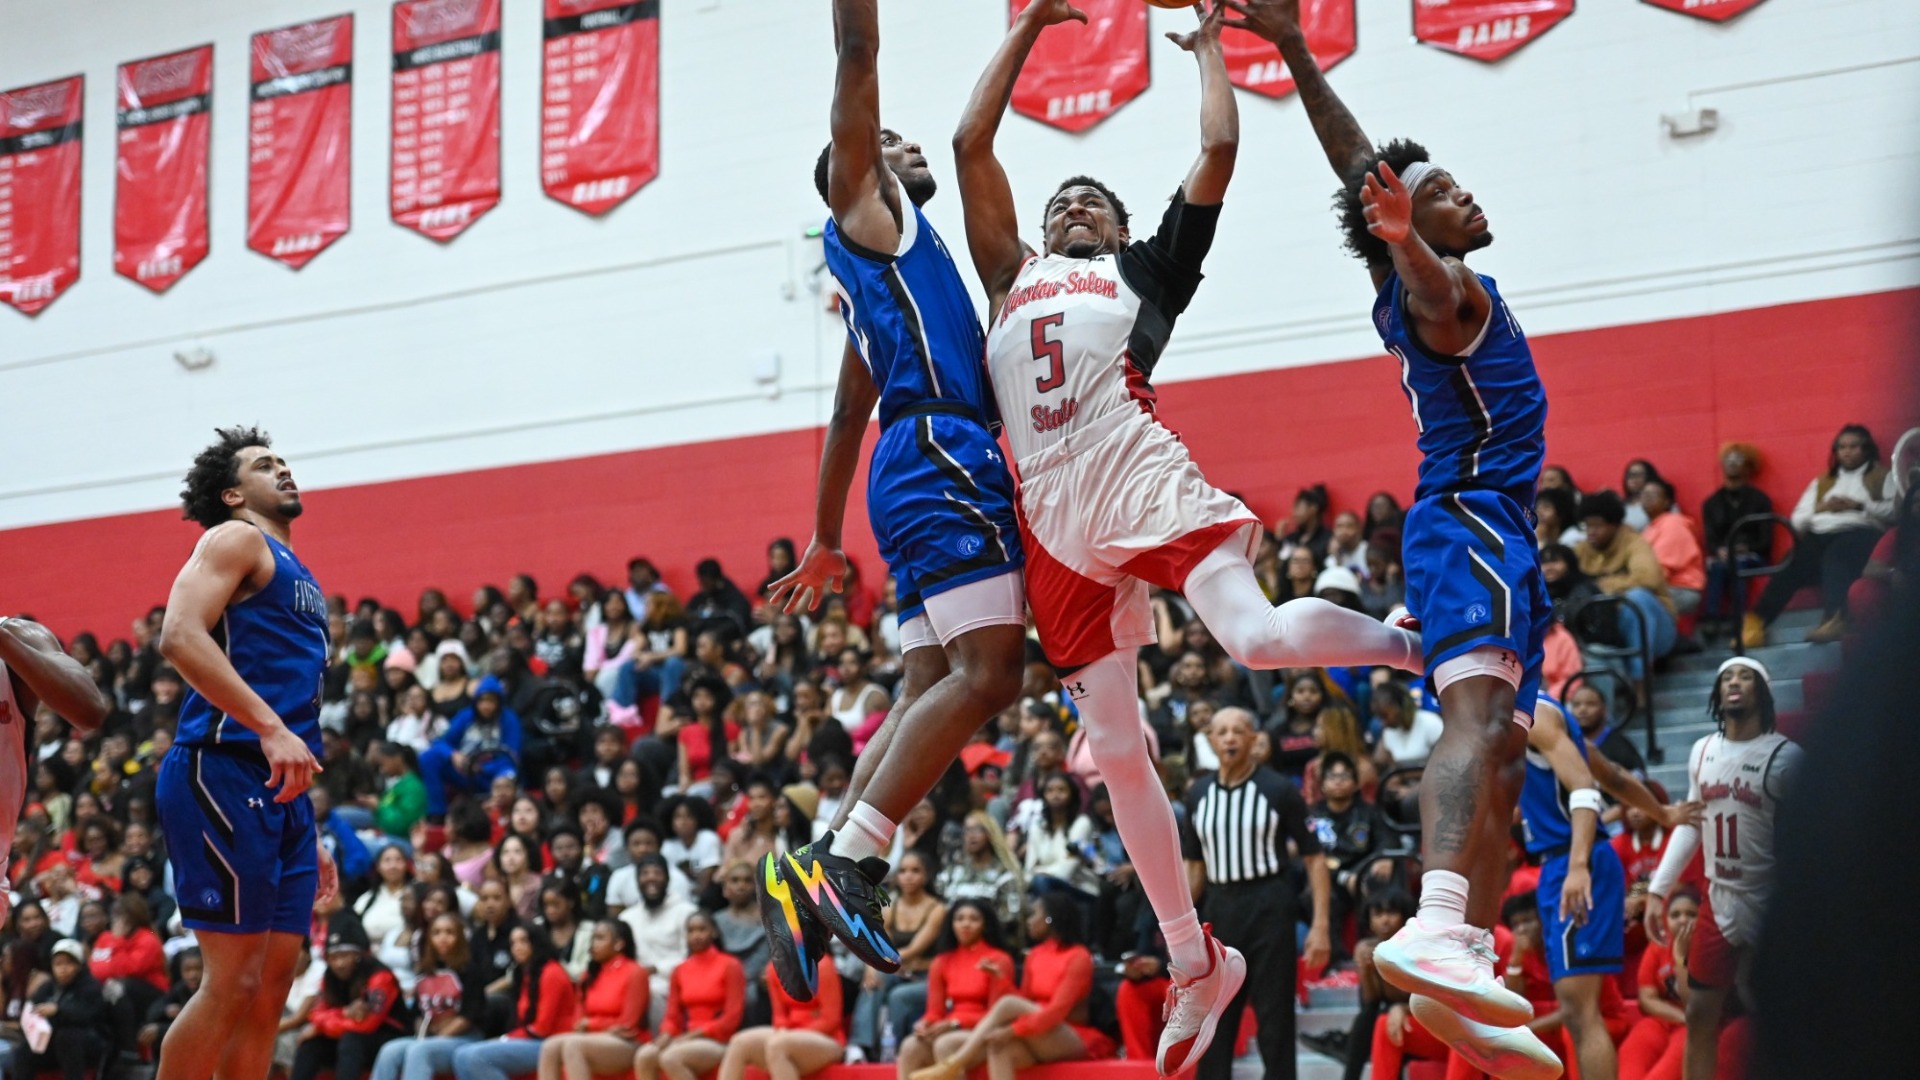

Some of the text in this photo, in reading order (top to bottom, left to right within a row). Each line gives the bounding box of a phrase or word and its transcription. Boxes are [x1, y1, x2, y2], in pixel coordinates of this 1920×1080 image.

[1457, 15, 1531, 49] RAMS
[1046, 89, 1112, 121] RAMS
[571, 175, 630, 205] RAMS
[1031, 311, 1065, 394] 5
[1031, 397, 1078, 433] State
[1715, 812, 1741, 859] 11
